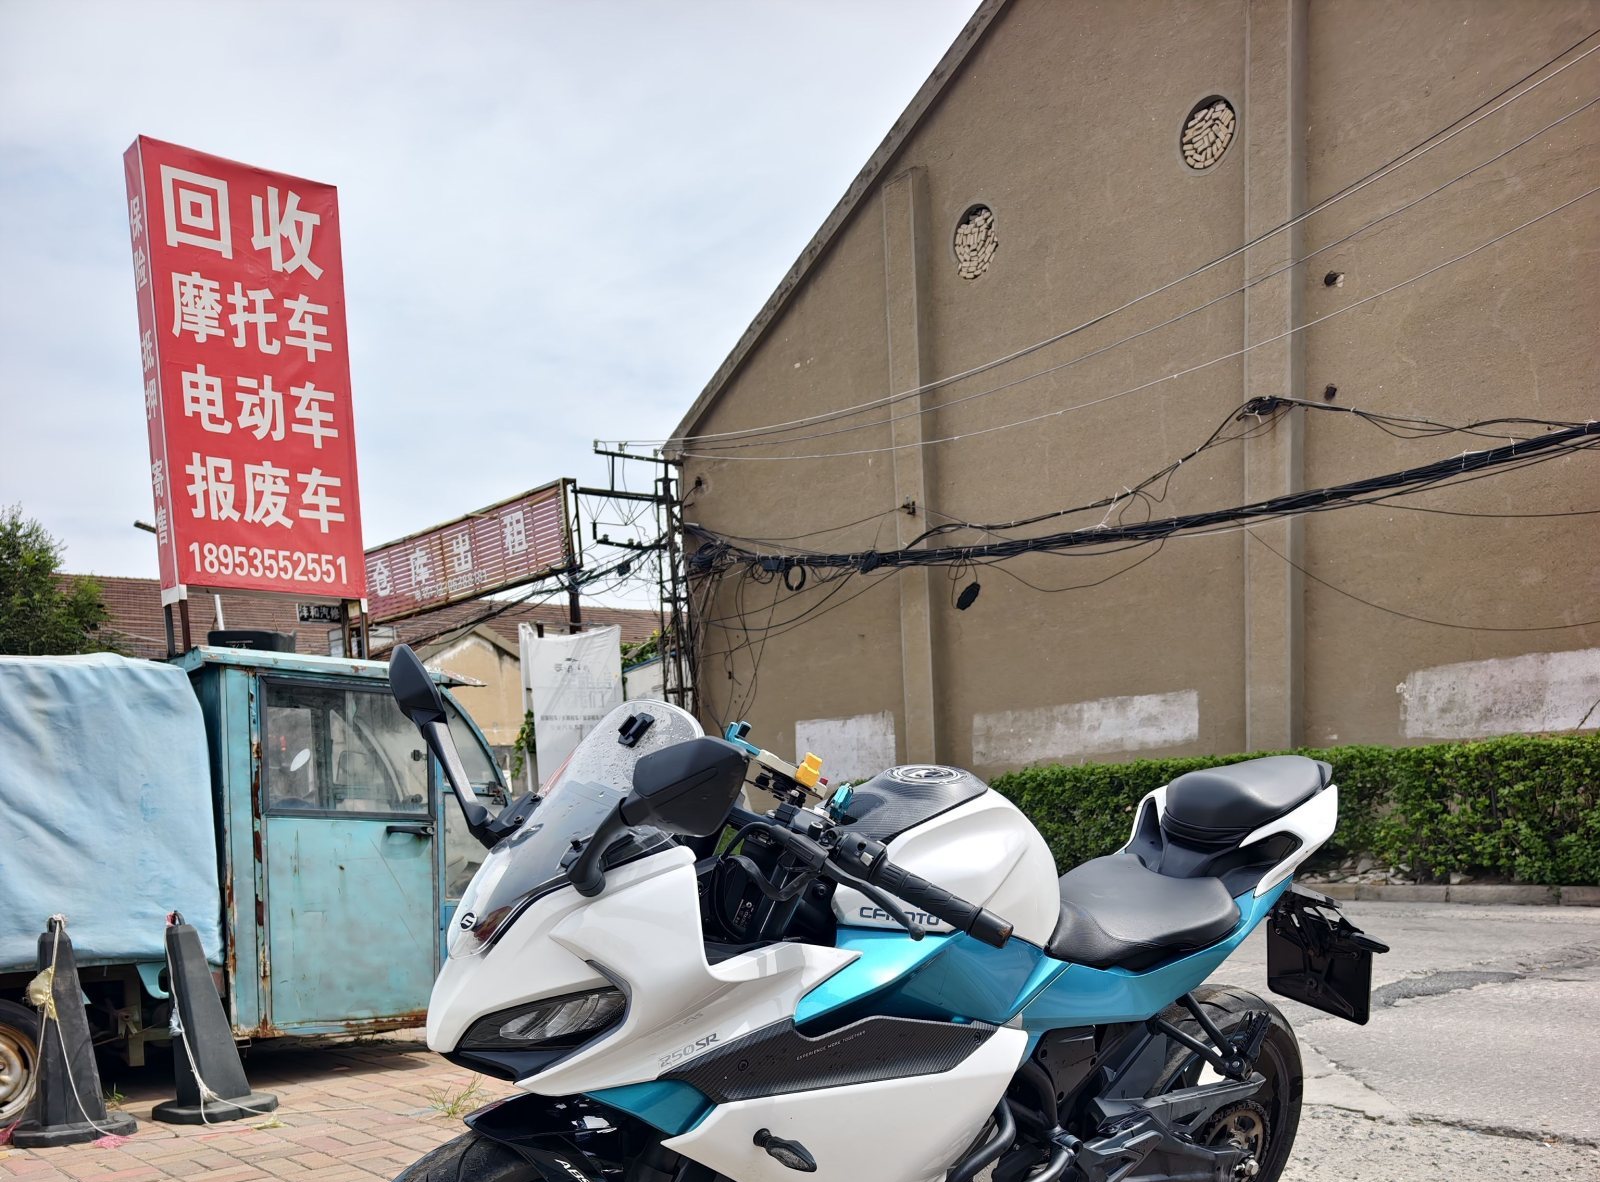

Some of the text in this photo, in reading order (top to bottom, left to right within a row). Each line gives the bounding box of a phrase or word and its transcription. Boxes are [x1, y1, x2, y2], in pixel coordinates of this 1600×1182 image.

[160, 164, 324, 280] 回收
[171, 271, 333, 363] 摩托车
[181, 364, 339, 449] 电动车
[185, 452, 346, 534] 报废车
[188, 541, 349, 585] 18953552551
[373, 510, 529, 598] 仓库出租
[659, 1032, 720, 1069] 250SR
